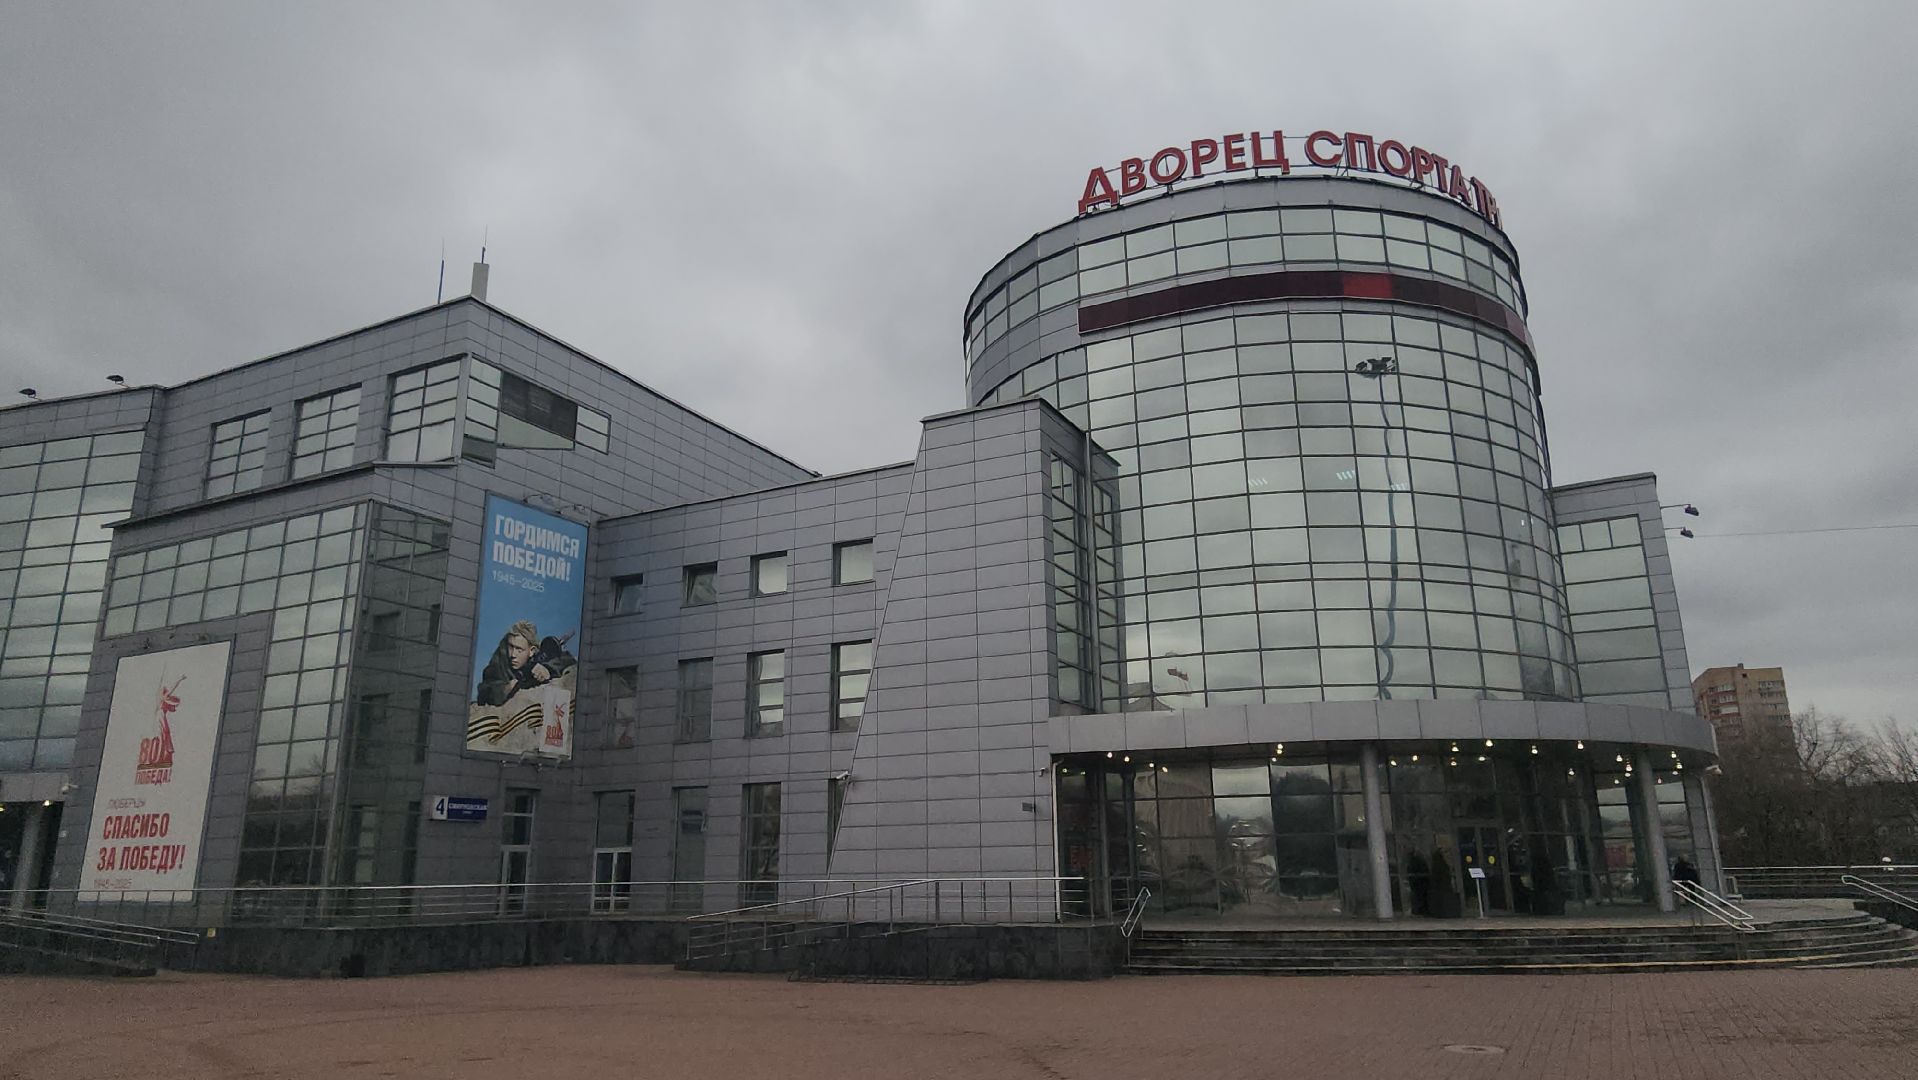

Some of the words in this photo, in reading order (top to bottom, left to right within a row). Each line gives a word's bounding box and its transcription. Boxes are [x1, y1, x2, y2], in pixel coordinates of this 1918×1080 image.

[1078, 130, 1290, 215] ДВОРЕЦ
[1305, 130, 1472, 206] СПОРТА
[495, 514, 580, 560] ГОРДИМСЯ
[493, 540, 571, 582] ПОБЕДОЙ!
[135, 769, 172, 786] ПОБЕДА!
[436, 798, 445, 815] 4
[103, 812, 170, 840] СПАСИБО
[97, 847, 116, 871] ЗА
[119, 845, 186, 873] ПОБЕДУ!
